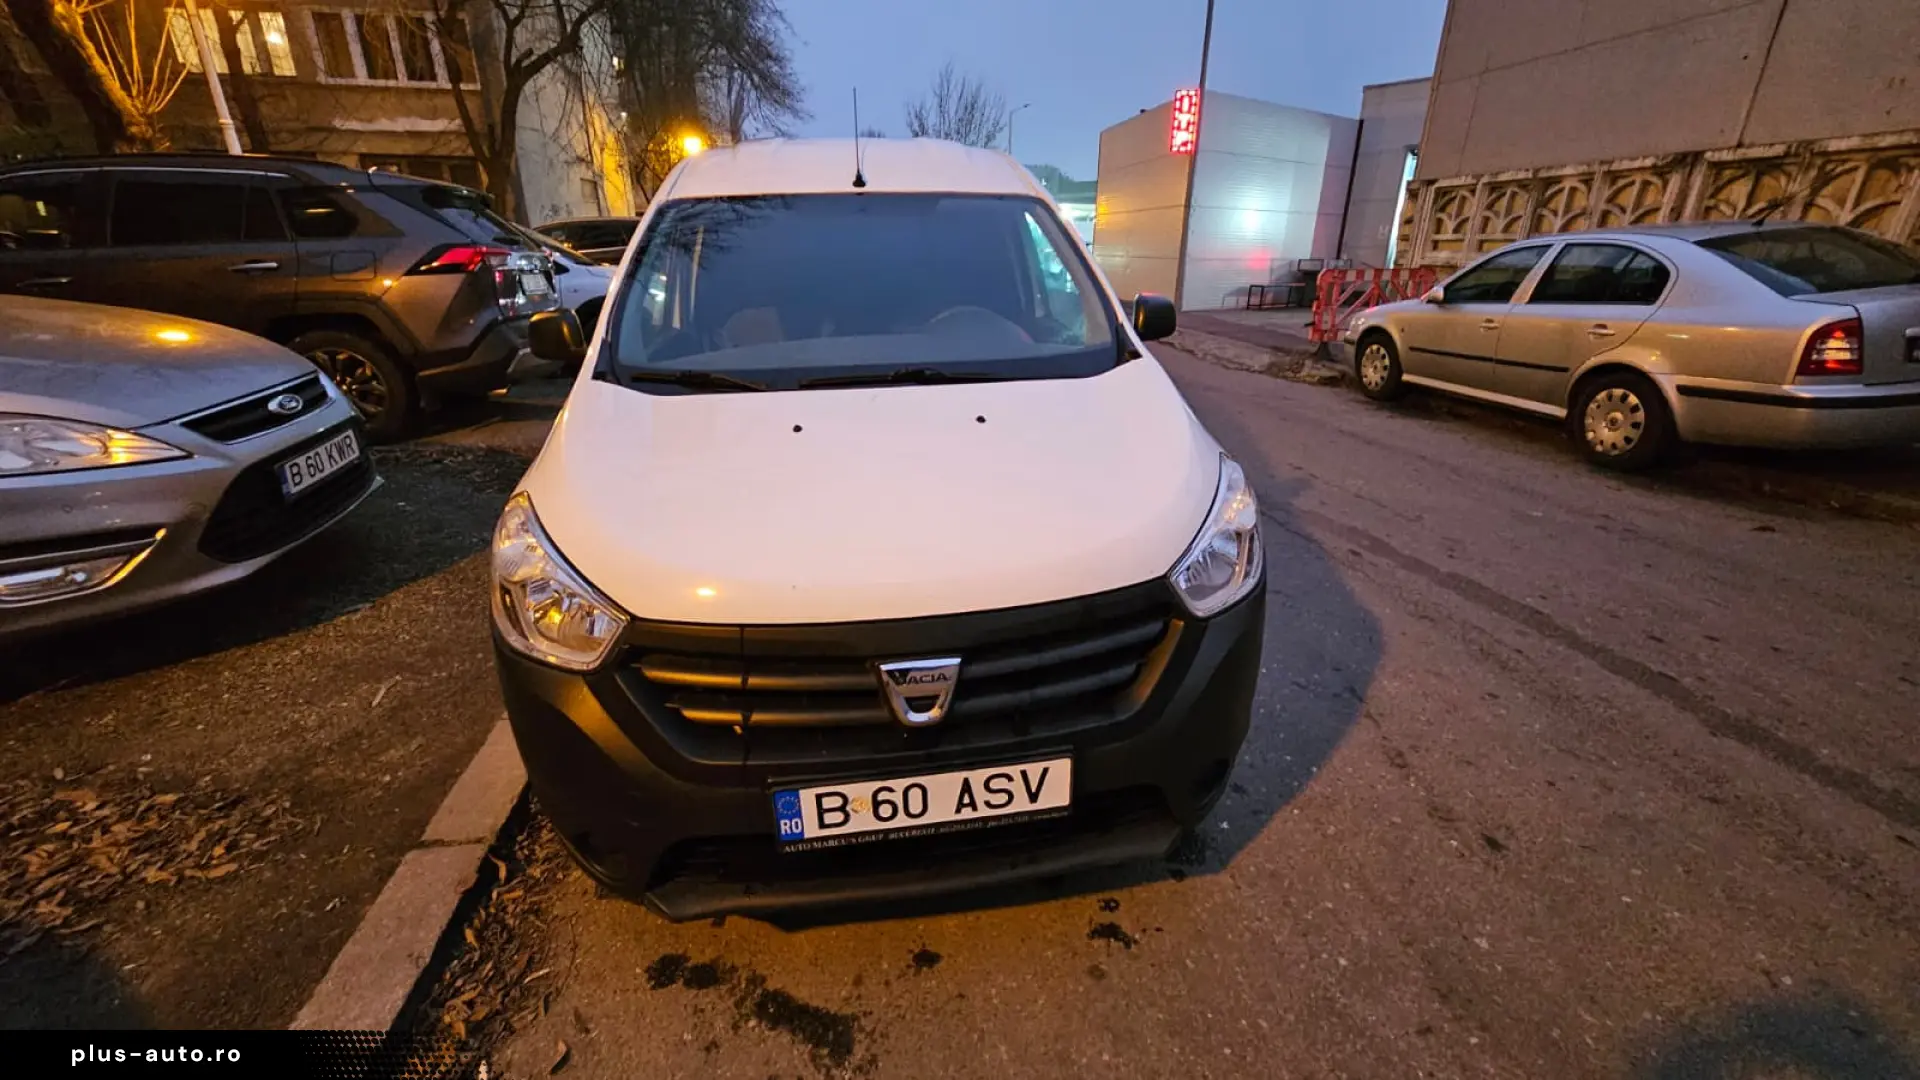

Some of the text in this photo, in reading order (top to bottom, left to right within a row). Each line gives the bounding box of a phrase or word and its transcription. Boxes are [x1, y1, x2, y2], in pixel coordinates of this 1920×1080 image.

[288, 435, 356, 488] B 60 KWR
[815, 766, 1050, 830] B 60 ASV
[779, 817, 803, 836] RO
[783, 843, 811, 854] AUTO
